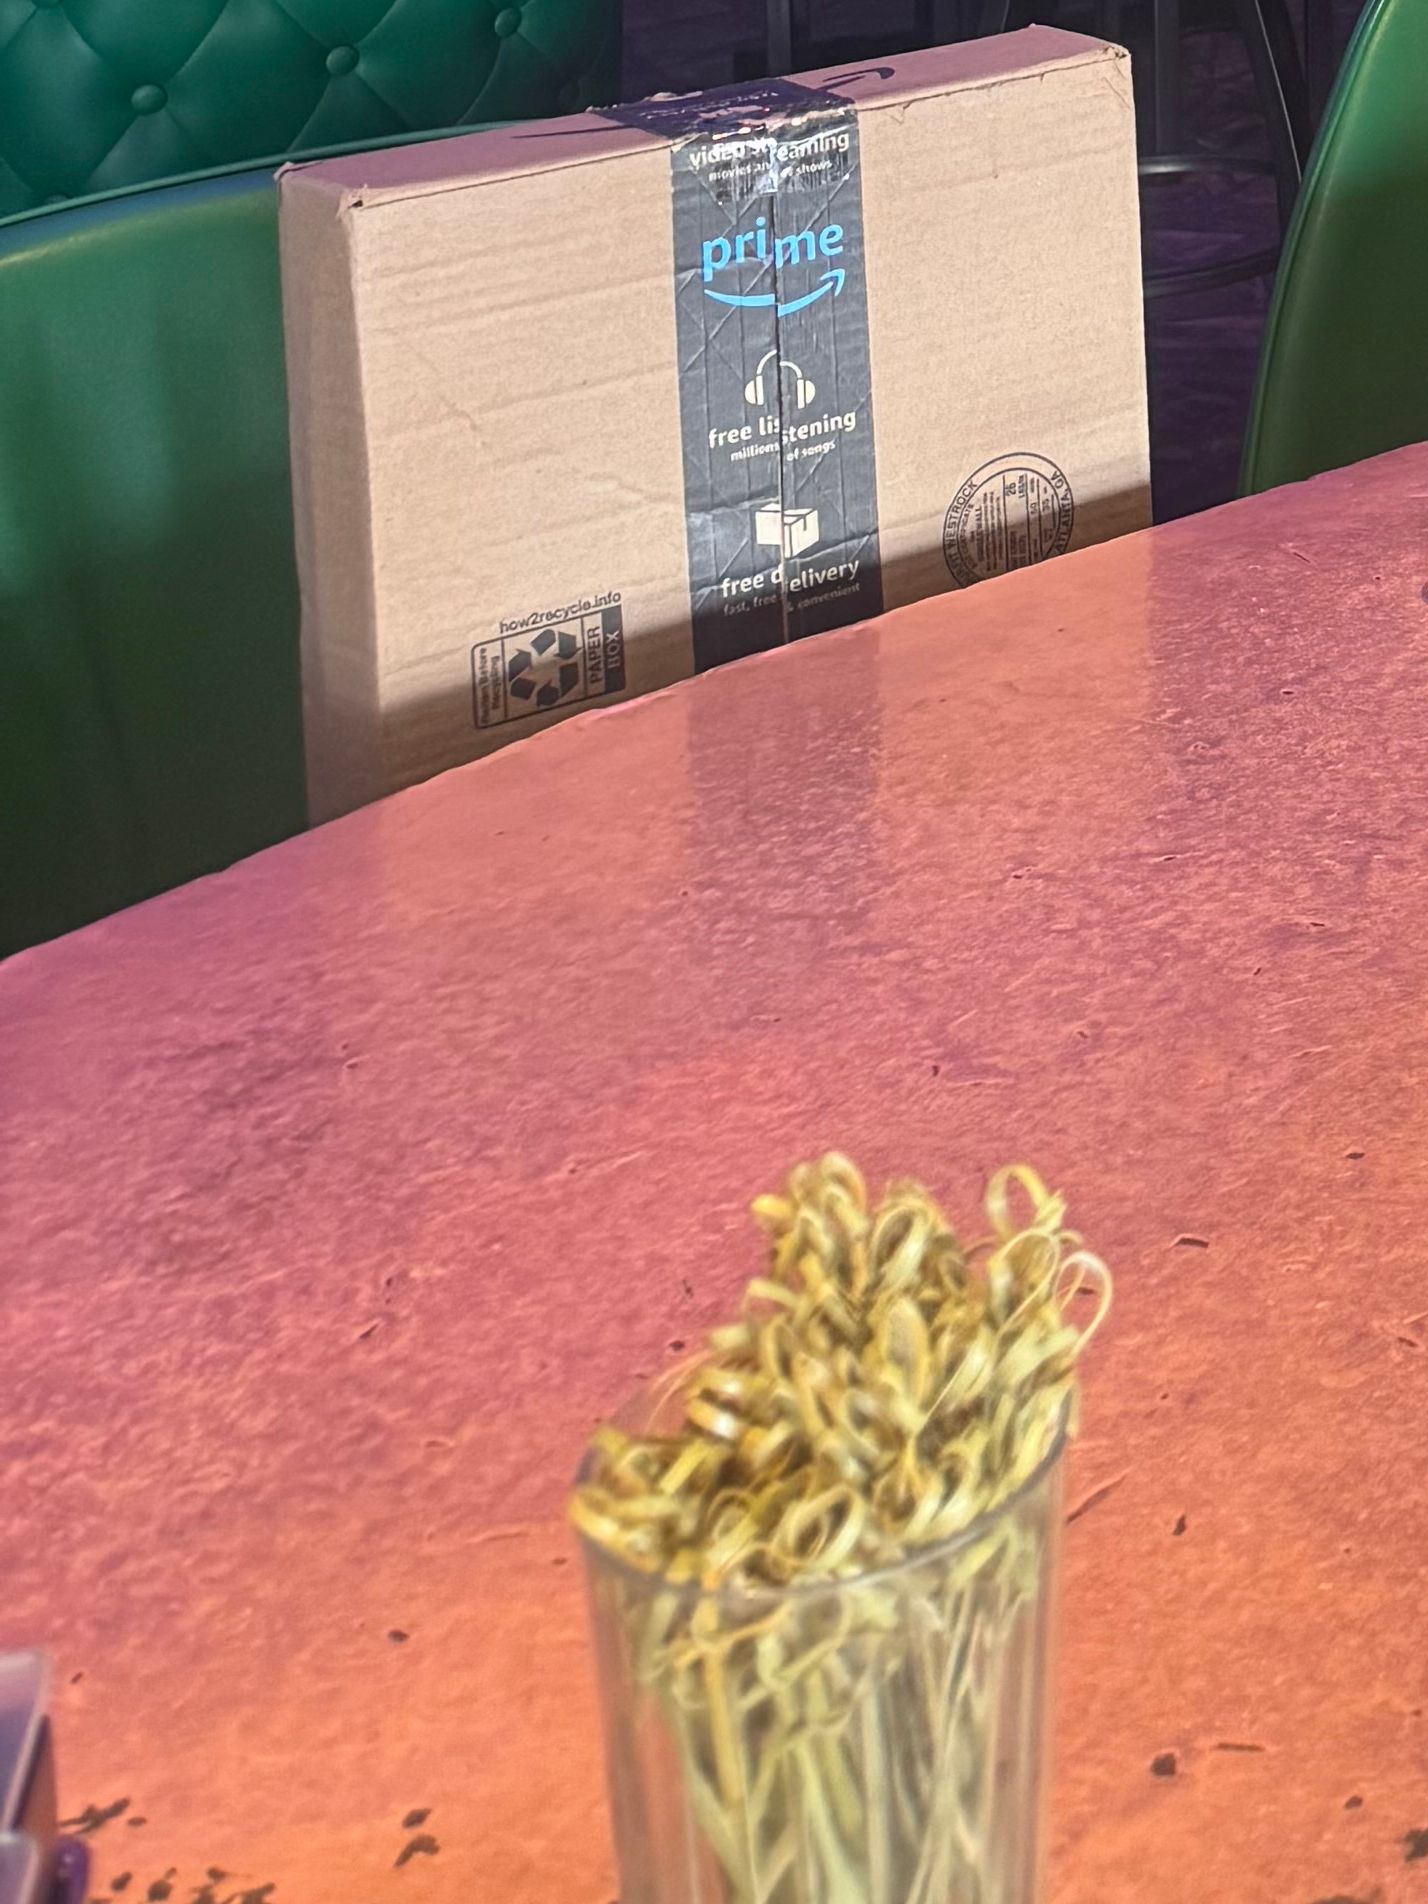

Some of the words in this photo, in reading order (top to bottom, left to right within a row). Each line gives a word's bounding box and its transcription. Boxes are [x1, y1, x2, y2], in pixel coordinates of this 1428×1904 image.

[702, 216, 844, 282] prime
[708, 422, 752, 448] free
[758, 411, 857, 445] listening
[730, 442, 780, 462] millions
[786, 450, 799, 462] of
[801, 440, 836, 457] songs
[1051, 471, 1064, 489] GA
[945, 480, 977, 552] WESTROCK
[1057, 489, 1072, 552] ATLANTA,
[721, 573, 765, 598] free
[771, 560, 860, 593] delivery
[500, 592, 622, 633] how2recycle.info
[587, 626, 602, 684] PAPER
[606, 630, 621, 668] BOX
